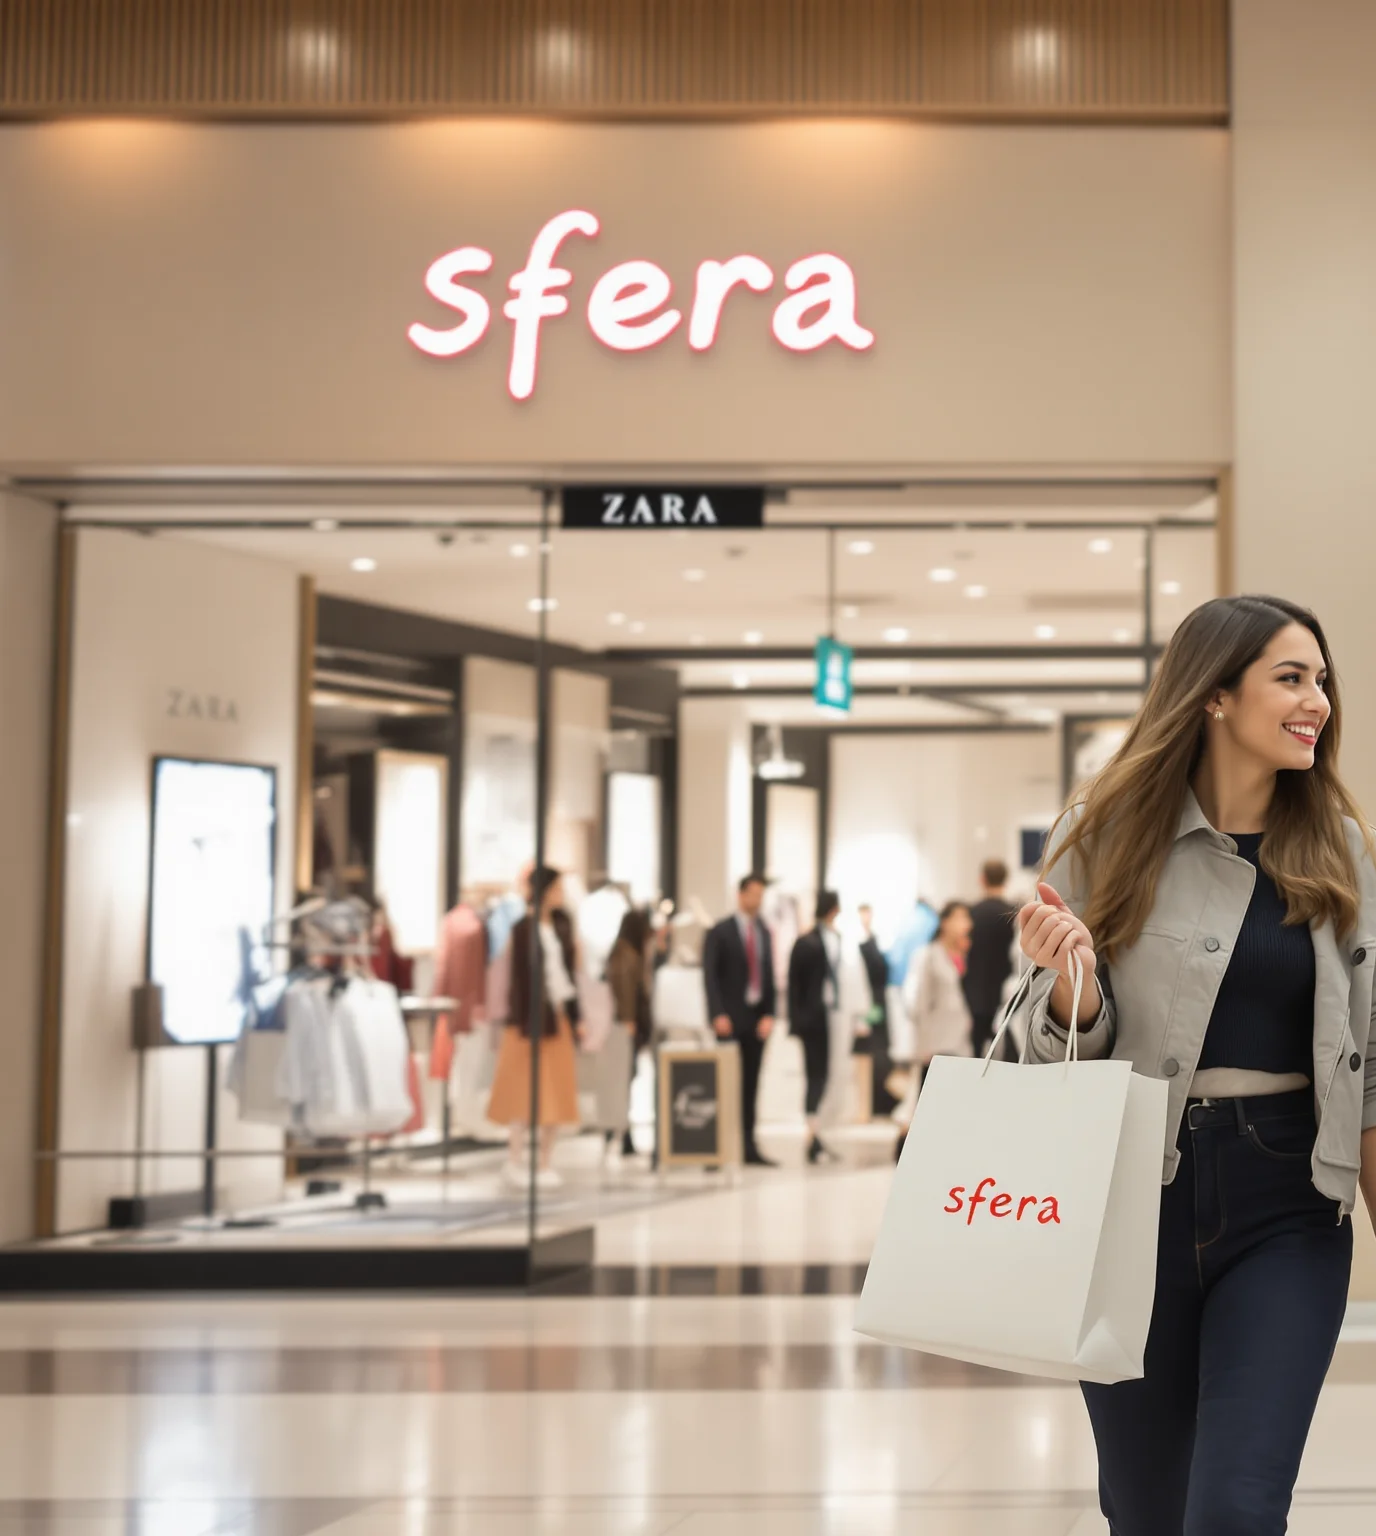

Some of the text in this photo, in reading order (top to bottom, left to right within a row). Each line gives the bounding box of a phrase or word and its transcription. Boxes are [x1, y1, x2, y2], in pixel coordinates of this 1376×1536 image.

[407, 208, 876, 401] sfera
[601, 492, 718, 525] ZARA
[943, 1177, 1061, 1226] sfera
